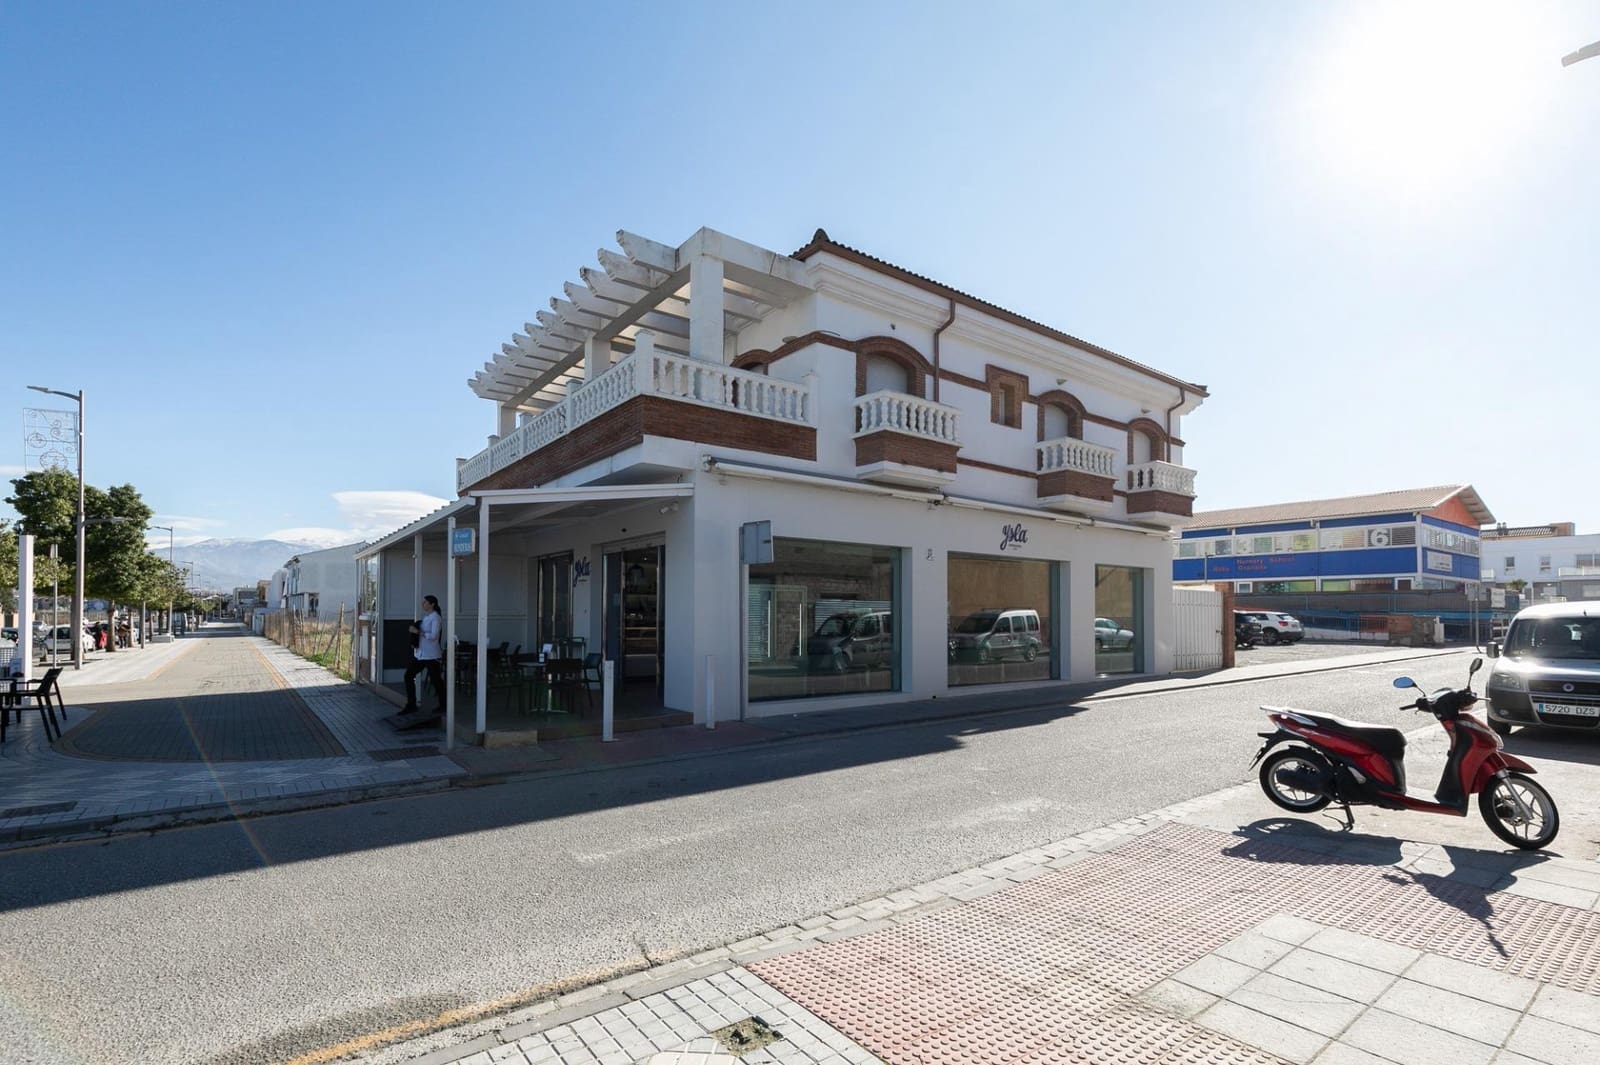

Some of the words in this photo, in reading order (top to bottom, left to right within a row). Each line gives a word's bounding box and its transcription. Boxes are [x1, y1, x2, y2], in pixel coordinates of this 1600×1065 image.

[1370, 528, 1389, 546] 6
[1545, 704, 1570, 713] 5720
[1576, 707, 1596, 715] DZS
